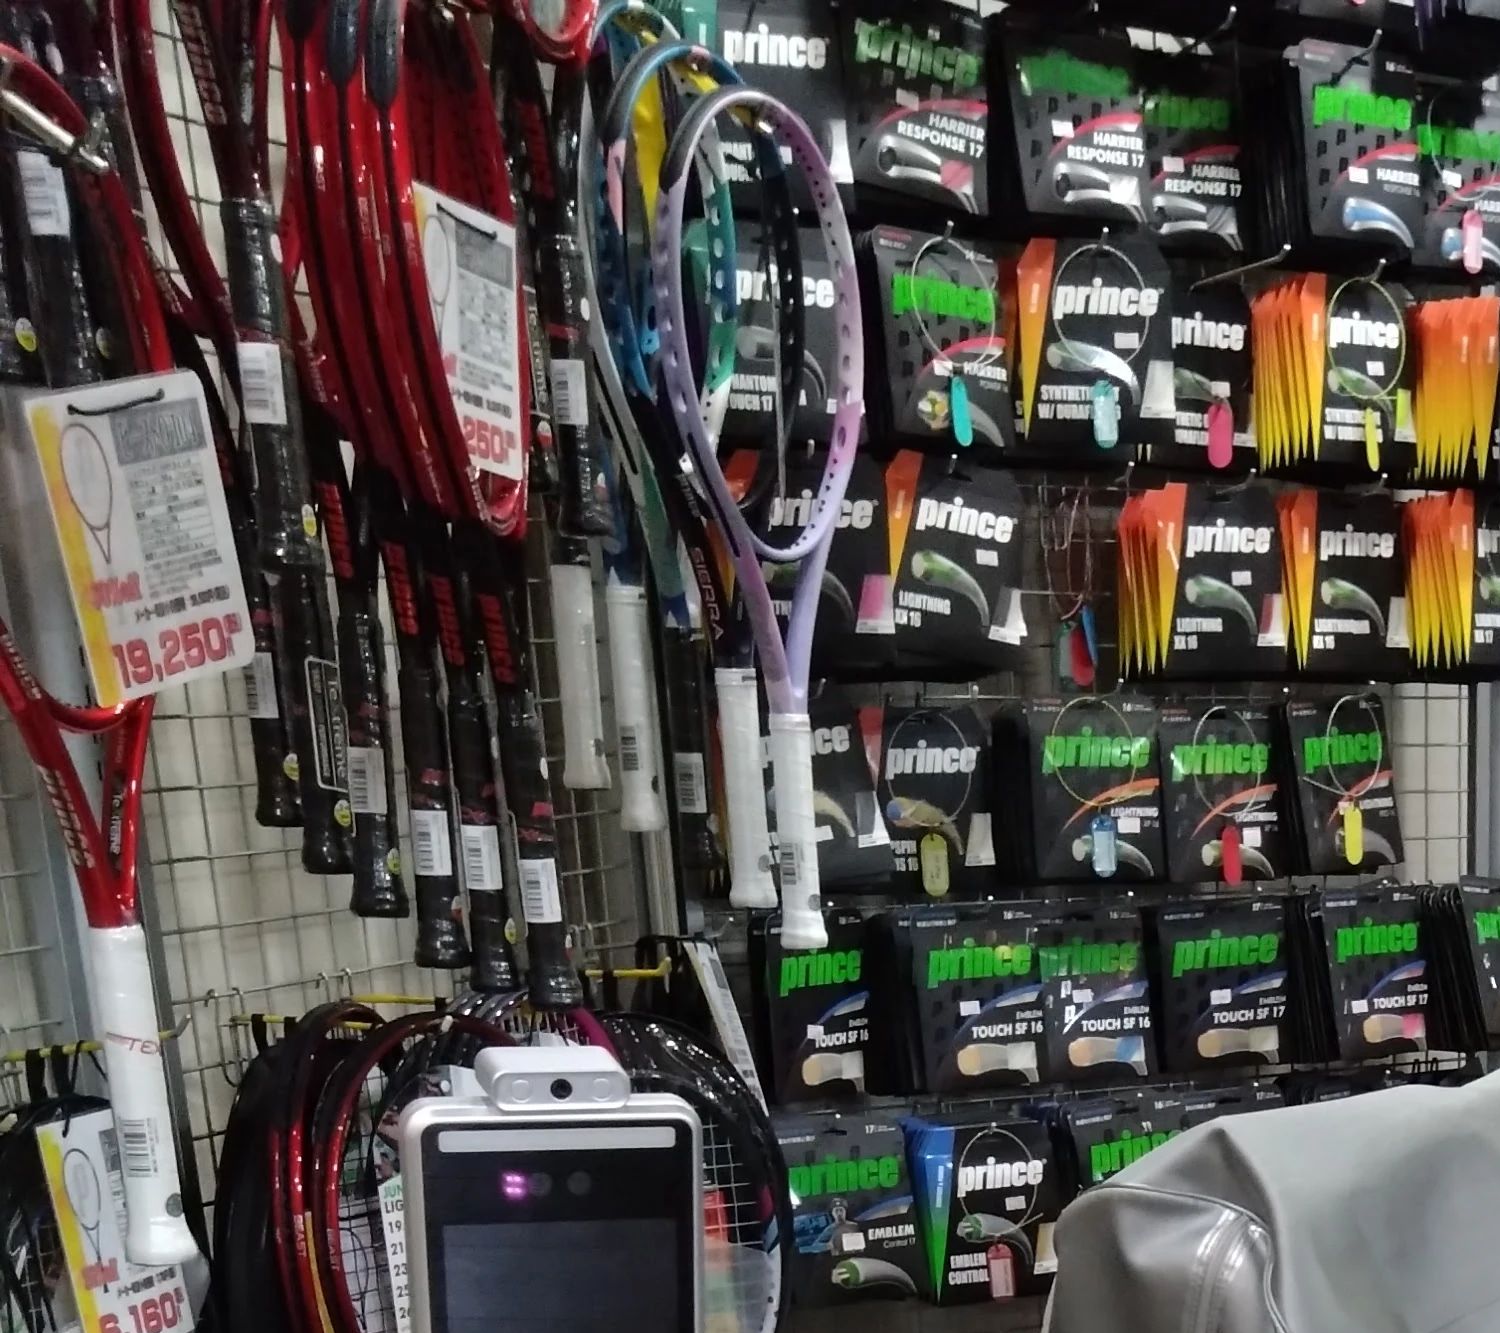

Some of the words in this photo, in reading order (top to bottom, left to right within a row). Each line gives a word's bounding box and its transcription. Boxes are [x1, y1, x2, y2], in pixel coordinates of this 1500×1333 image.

[724, 24, 827, 70] prince
[856, 19, 982, 88] prince
[897, 120, 966, 152] RESPONSE
[968, 141, 985, 159] 17
[928, 113, 985, 142] HARRIER
[1092, 131, 1143, 152] HARRIER
[1066, 144, 1126, 167] RESPONSE
[1131, 153, 1145, 168] 17
[1191, 163, 1240, 182] HARRIER
[1164, 178, 1226, 197] RESPONSE
[1228, 183, 1242, 198] 17
[1053, 278, 1161, 319] prince
[1171, 311, 1246, 351] prince
[1329, 311, 1399, 350] prince
[916, 496, 1018, 544] prince
[1185, 518, 1272, 559] prince
[1320, 524, 1395, 561] prince
[885, 739, 978, 780] prince
[1042, 726, 1151, 775] prince
[1171, 734, 1269, 783] prince
[1304, 726, 1383, 775] prince
[1173, 929, 1281, 978] prince
[1336, 917, 1420, 964] prince
[780, 948, 862, 997] prince
[927, 937, 1032, 989] prince
[1213, 1007, 1254, 1024] TOUCH
[1256, 1006, 1270, 1021] SF
[1272, 1005, 1286, 1018] 17
[1373, 995, 1405, 1011] TOUCH
[1405, 994, 1416, 1007] SF
[1417, 993, 1428, 1006] 17
[972, 1022, 1014, 1040] TOUCH
[1014, 1022, 1029, 1036] SF
[1031, 1020, 1044, 1034] 16
[1082, 1016, 1121, 1032] TOUCH
[1122, 1016, 1138, 1030] SF
[1139, 1015, 1151, 1029] 16
[789, 1154, 899, 1207] prince
[957, 1156, 1044, 1198] prince
[868, 1223, 916, 1241] EMBLEM
[950, 1252, 987, 1270] EMBLEM
